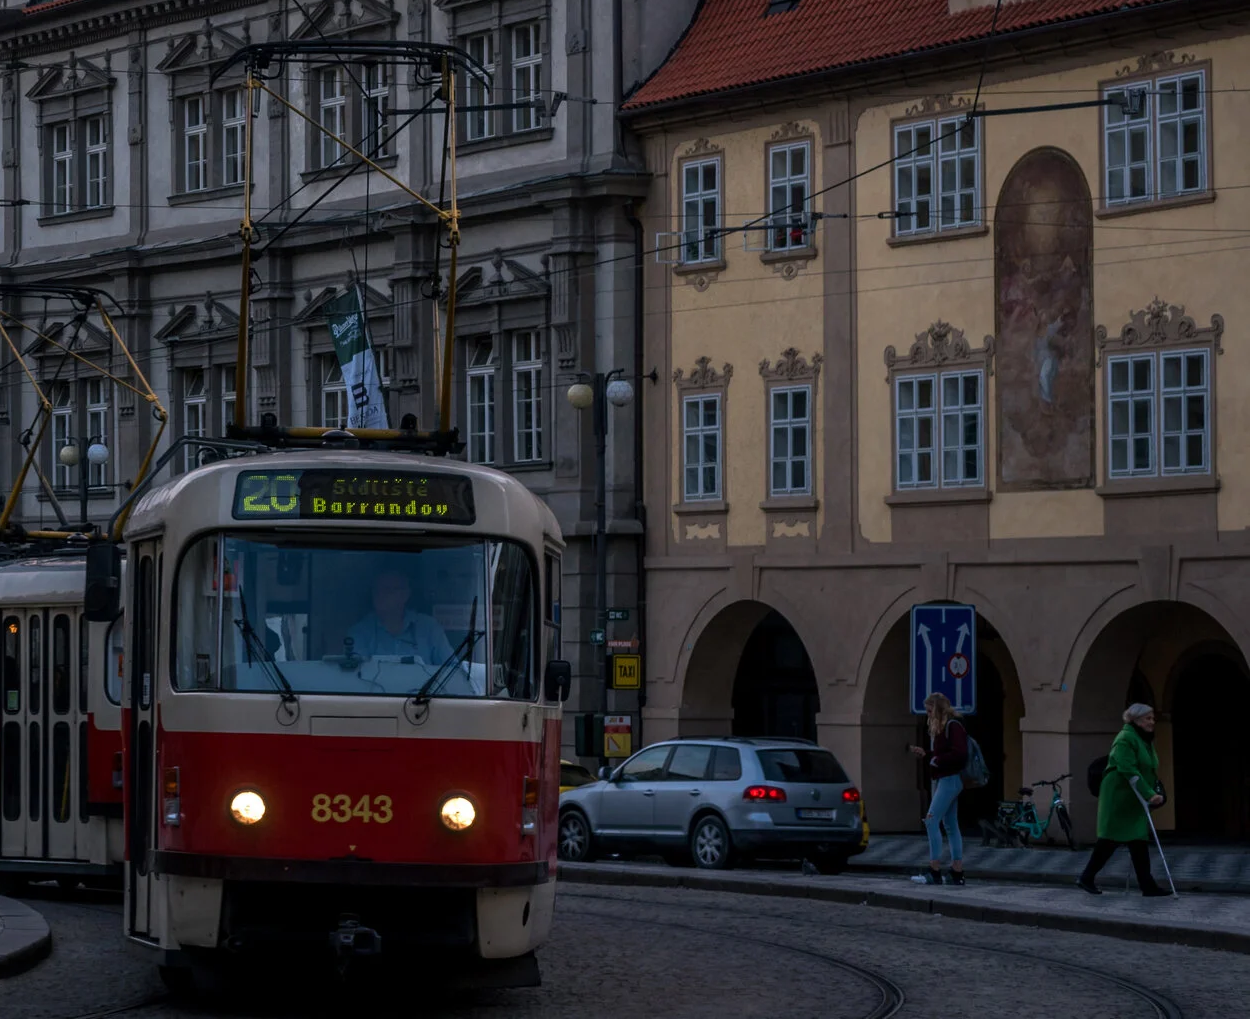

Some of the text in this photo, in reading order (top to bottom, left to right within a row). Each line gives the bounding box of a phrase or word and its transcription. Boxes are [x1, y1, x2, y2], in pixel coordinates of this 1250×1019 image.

[243, 475, 297, 512] 20
[312, 497, 448, 516] Barrandov
[618, 665, 635, 678] TAXI
[311, 793, 394, 824] 8343
